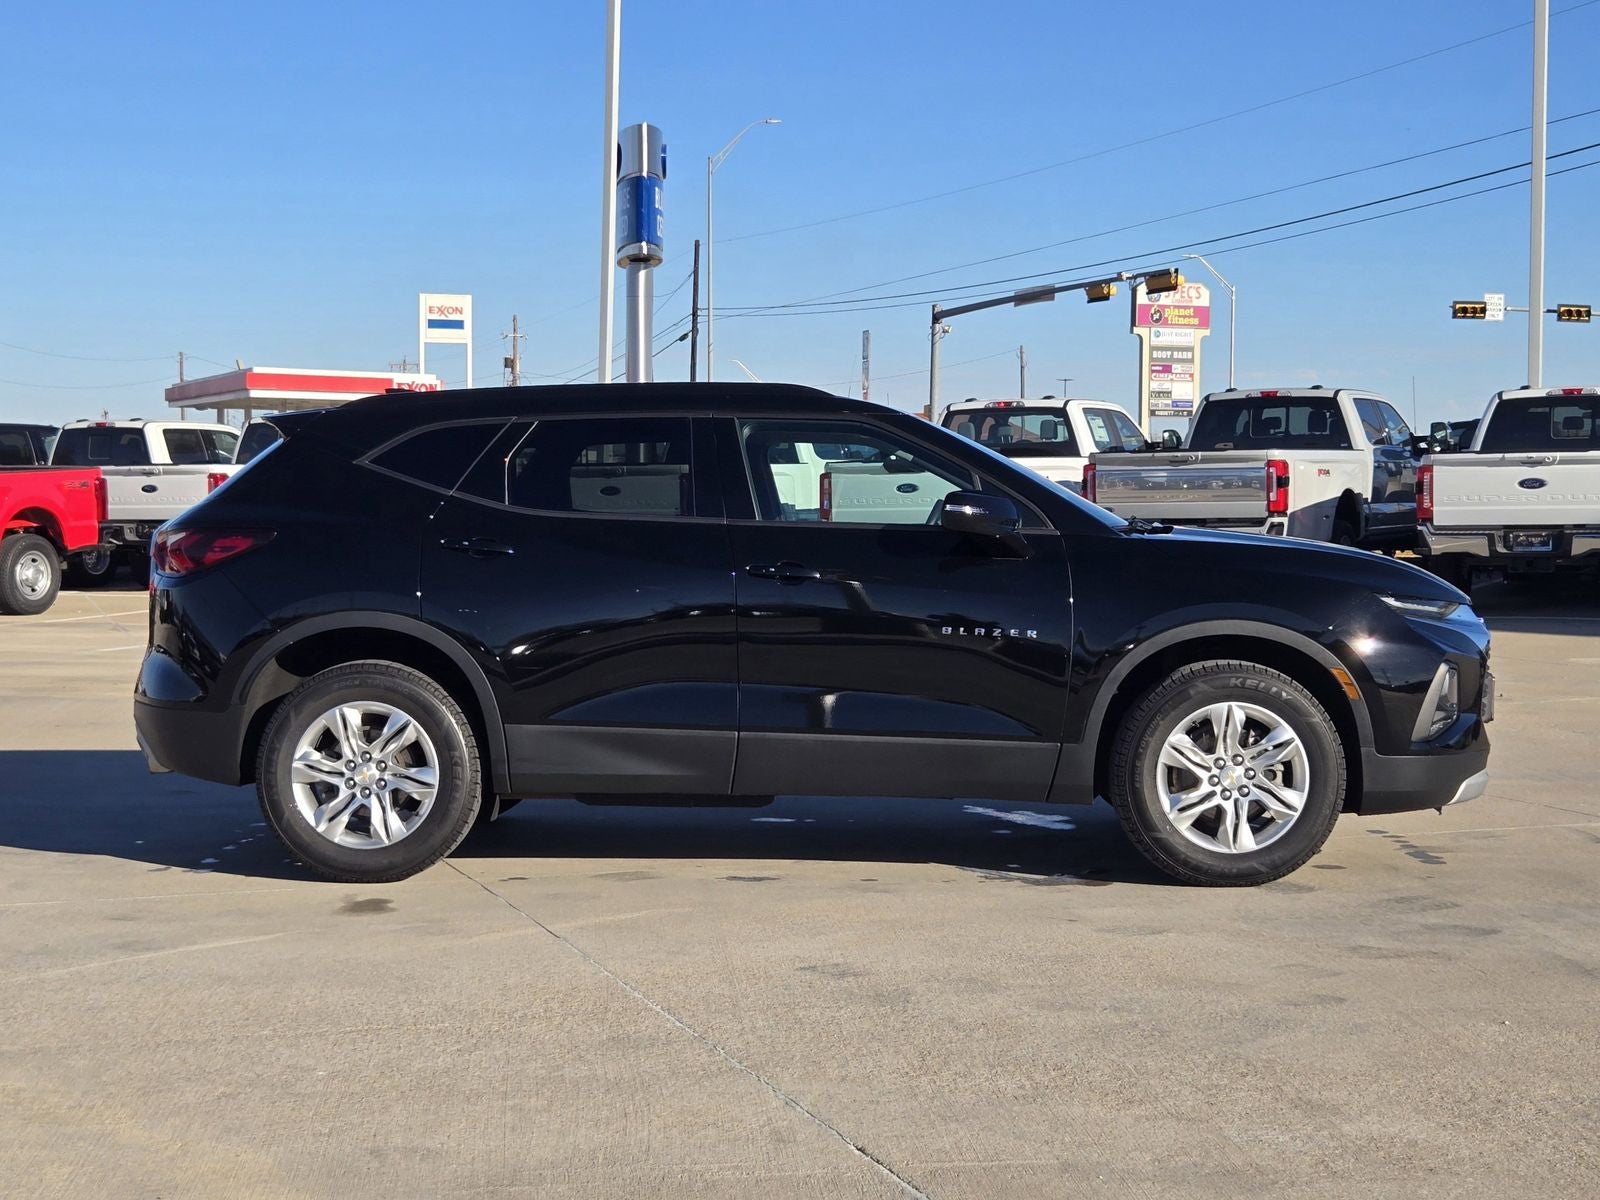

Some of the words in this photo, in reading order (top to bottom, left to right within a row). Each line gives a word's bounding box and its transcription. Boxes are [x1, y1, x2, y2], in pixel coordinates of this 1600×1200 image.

[428, 305, 463, 318] EXXON
[1165, 307, 1194, 318] planet
[1168, 316, 1199, 325] fitness
[1152, 350, 1171, 359] BOOT
[1173, 351, 1192, 359] BARN
[1443, 494, 1539, 503] SUPER
[942, 626, 1038, 638] BLAZER
[1228, 677, 1293, 702] KELLY
[1137, 712, 1162, 753] TOURING
